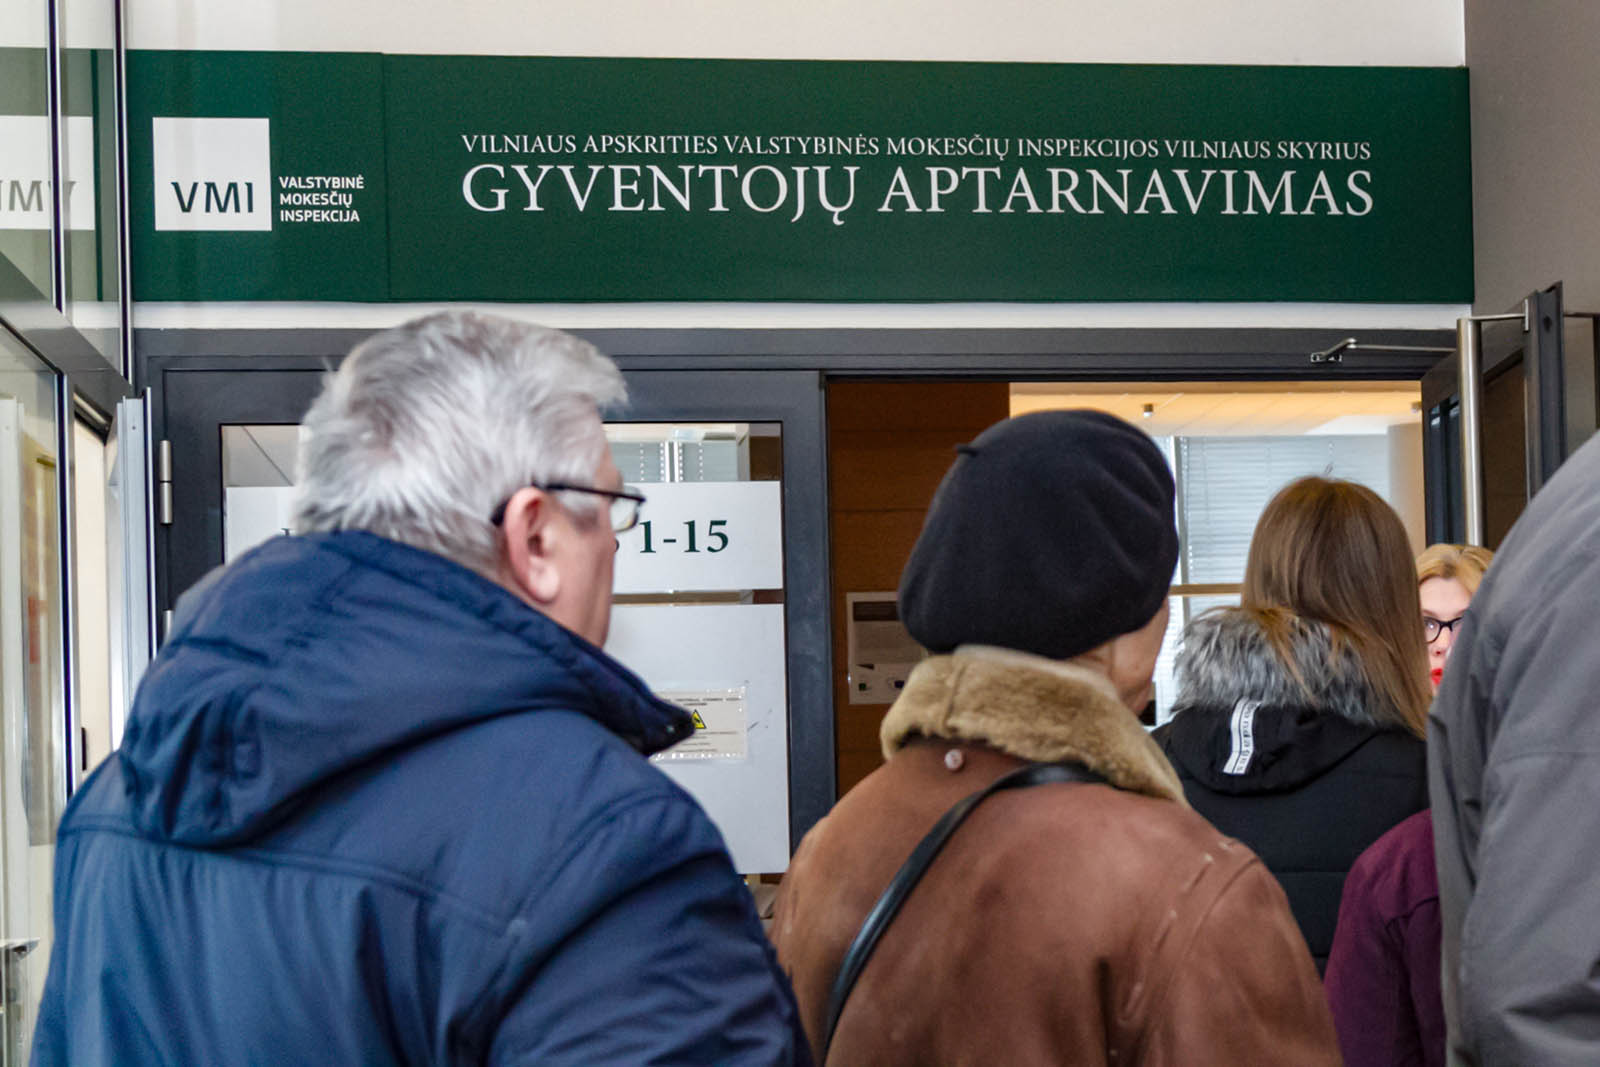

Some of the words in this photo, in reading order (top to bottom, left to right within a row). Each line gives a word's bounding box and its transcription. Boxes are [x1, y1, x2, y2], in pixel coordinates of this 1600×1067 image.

[461, 134, 577, 153] VILNIAUS
[582, 134, 718, 155] APSKRITIES
[723, 133, 880, 156] VALSTYBINĖS
[887, 133, 1010, 161] MOKESČIŲ
[1018, 138, 1159, 160] INSPEKCIJOS
[1164, 139, 1271, 159] VILNIAUS
[1277, 141, 1371, 160] SKYRIUS
[278, 173, 365, 189] VALSTYBINĖ
[462, 163, 861, 226] GYVENTOJŲ
[877, 166, 1373, 216] APTARNAVIMAS
[170, 181, 254, 213] VMI
[279, 190, 353, 208] MOKESČIŲ
[280, 209, 360, 223] INSPEKCIJA
[640, 519, 729, 553] 1-15
